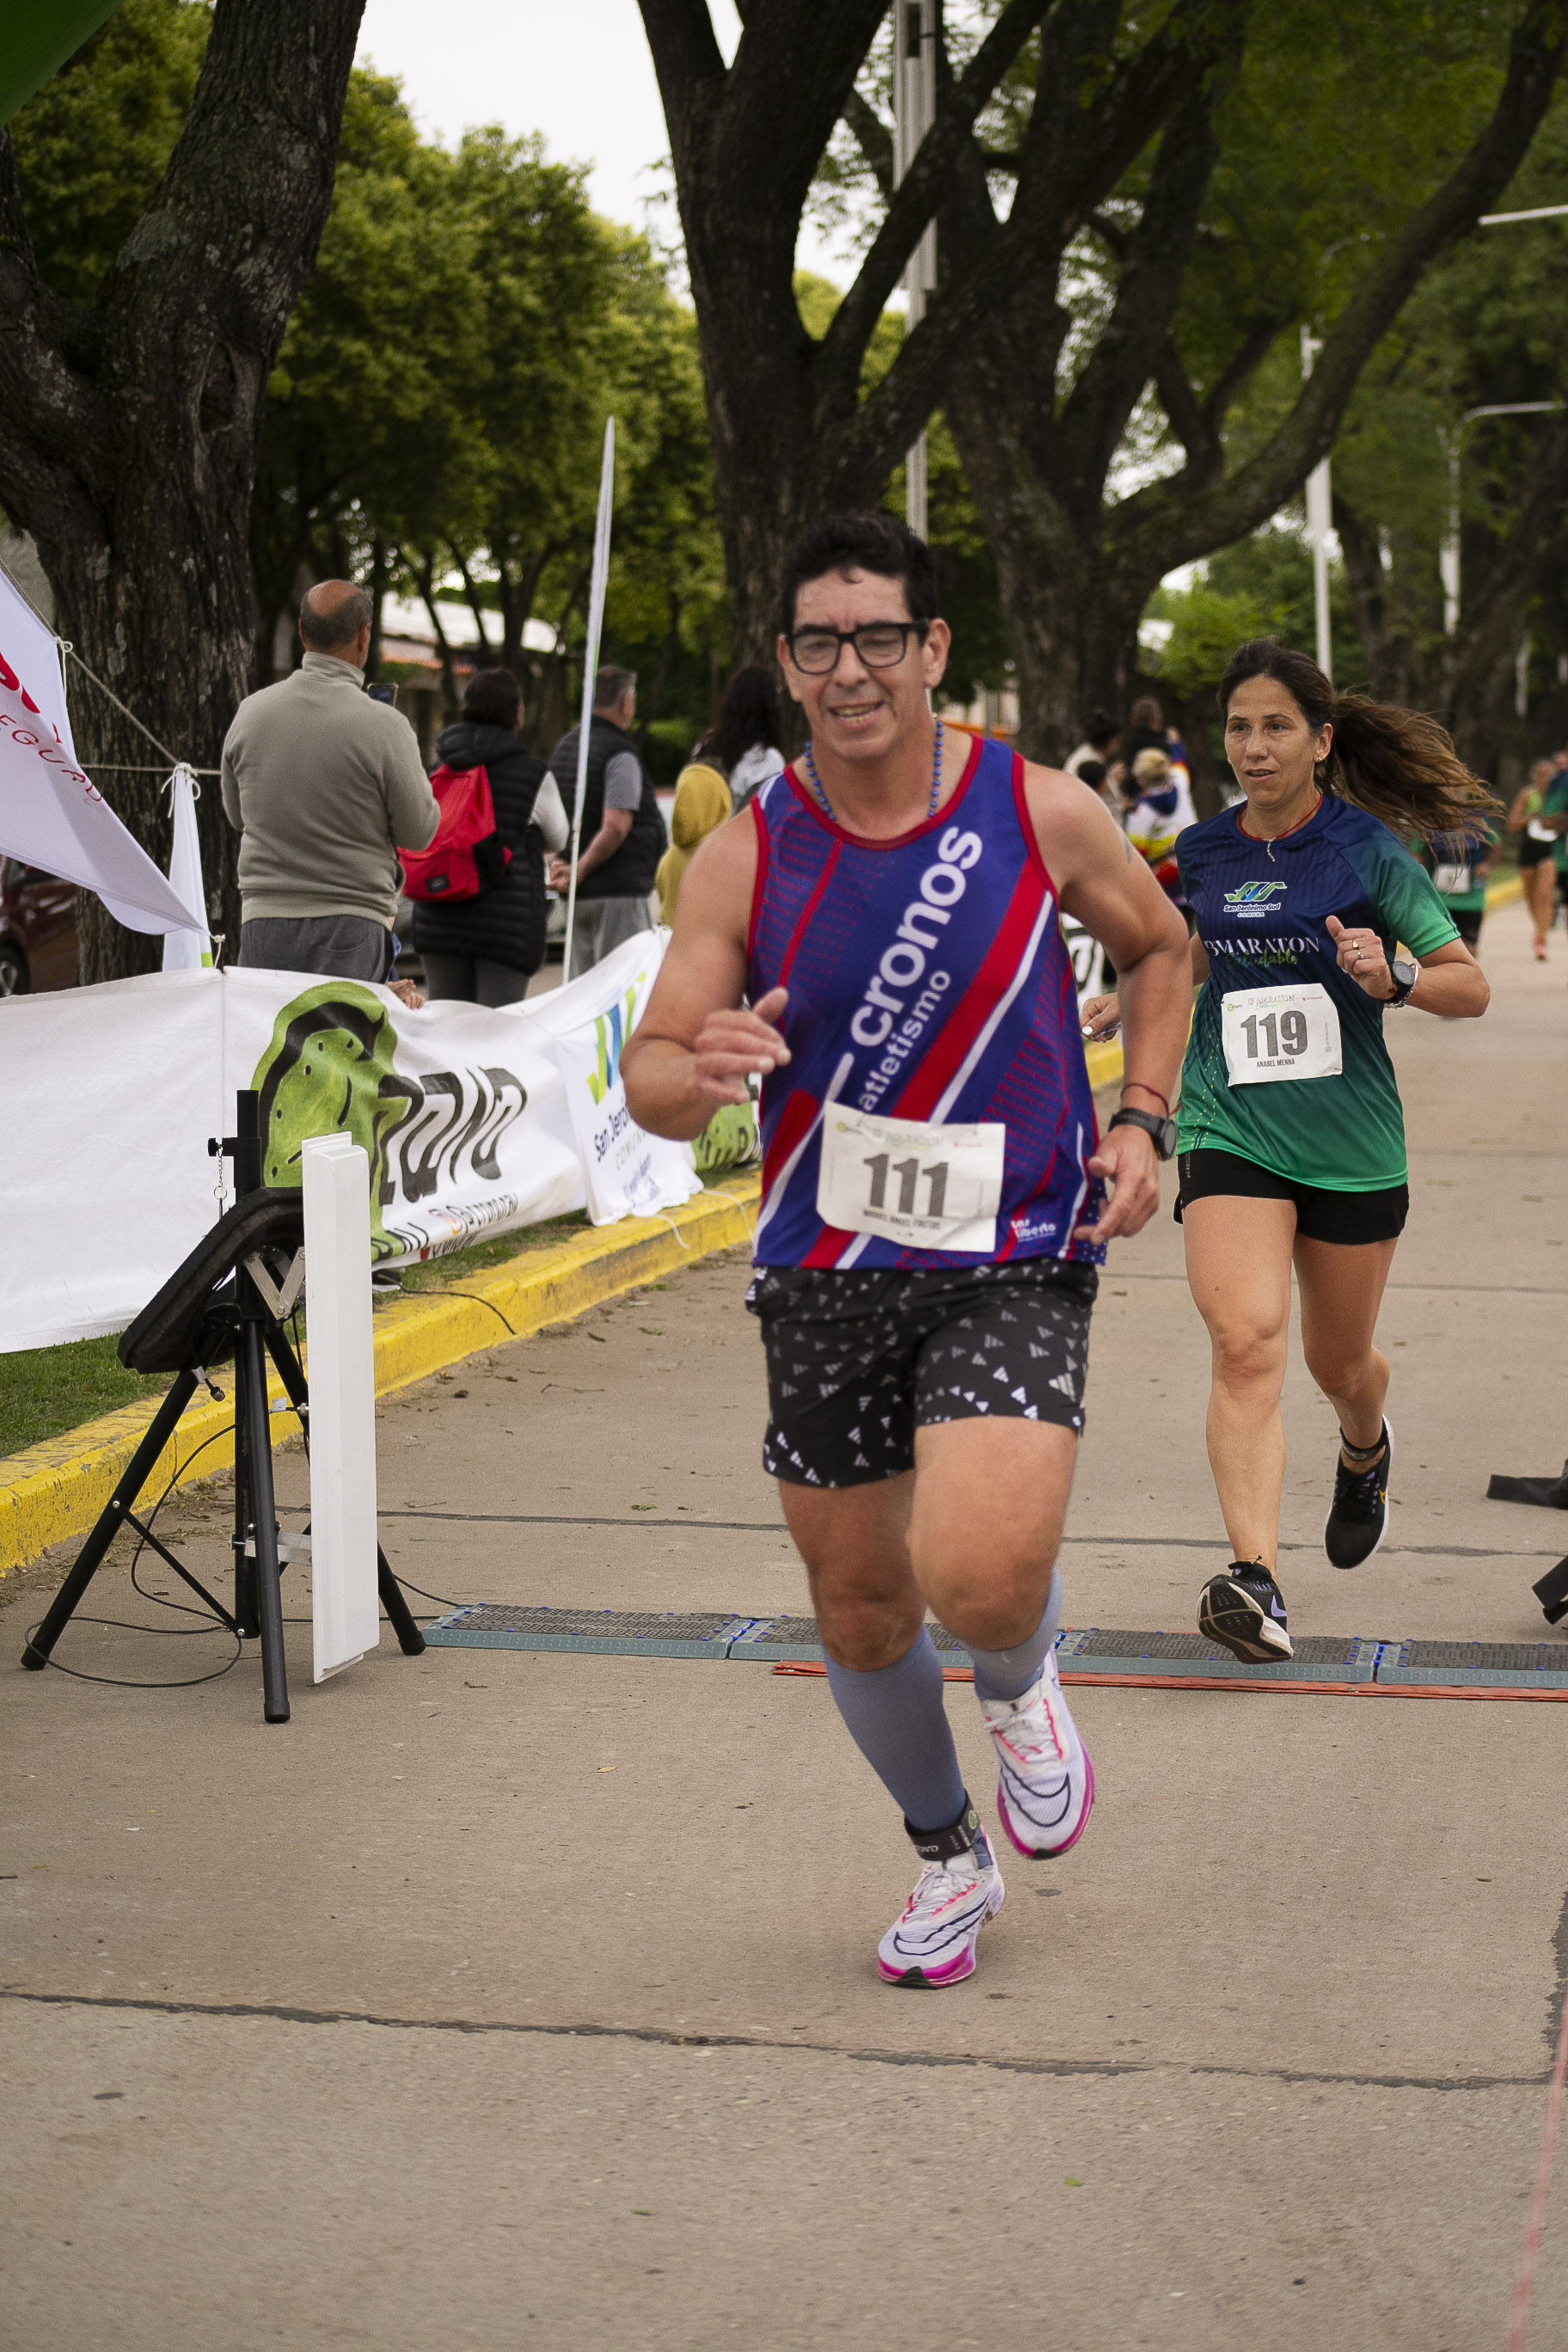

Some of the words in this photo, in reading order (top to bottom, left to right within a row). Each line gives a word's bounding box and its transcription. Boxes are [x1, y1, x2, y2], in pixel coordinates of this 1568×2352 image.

[851, 826, 983, 1047] cronos
[1216, 936, 1320, 954] MARATON
[859, 970, 951, 1112] atletismo
[1240, 1010, 1308, 1058] 119
[594, 1124, 610, 1162] San
[863, 1153, 948, 1217] 111
